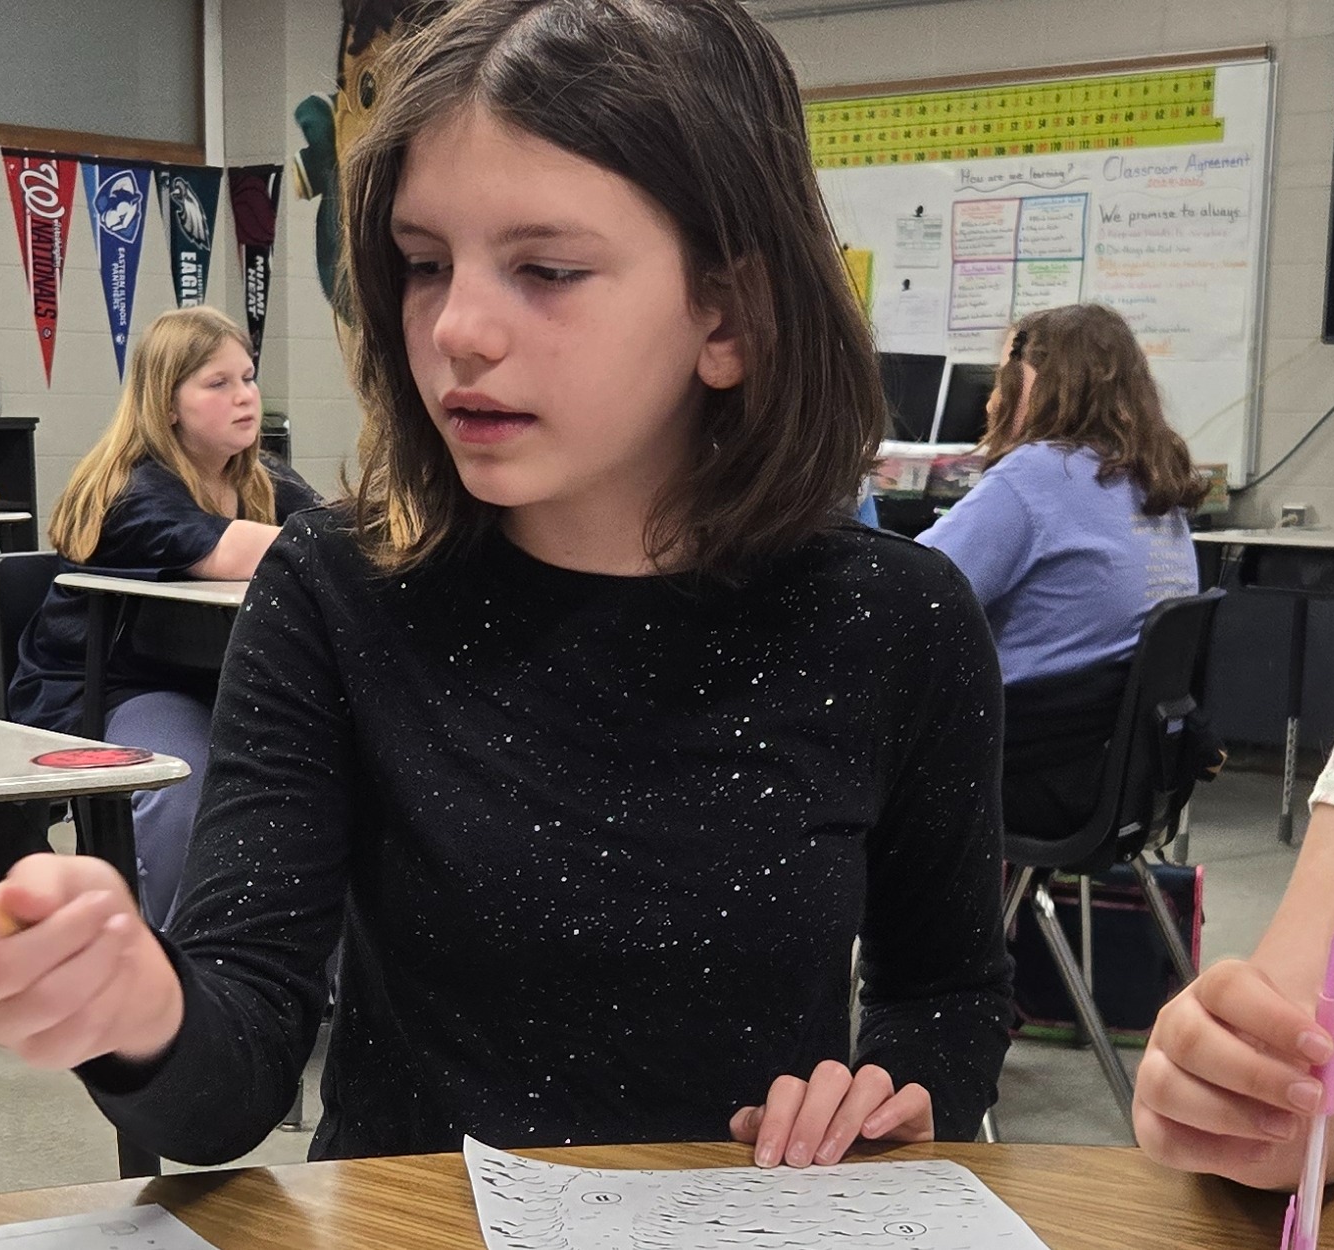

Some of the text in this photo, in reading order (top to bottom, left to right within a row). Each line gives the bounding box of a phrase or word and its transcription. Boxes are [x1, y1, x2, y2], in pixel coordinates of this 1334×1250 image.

[1203, 80, 1211, 90] 10
[960, 169, 983, 184] How
[988, 174, 1003, 182] are
[1029, 163, 1074, 183] learning?
[1102, 152, 1251, 182] Classroom Agreement
[1099, 203, 1241, 226] We promise to always
[31, 217, 57, 320] NATIONALS
[111, 262, 120, 310] PANTHERS
[117, 247, 127, 326] EASTERN ILLINOIS
[181, 251, 196, 308] EAGLE
[256, 255, 265, 315] MIAMI
[247, 268, 257, 320] HEAT
